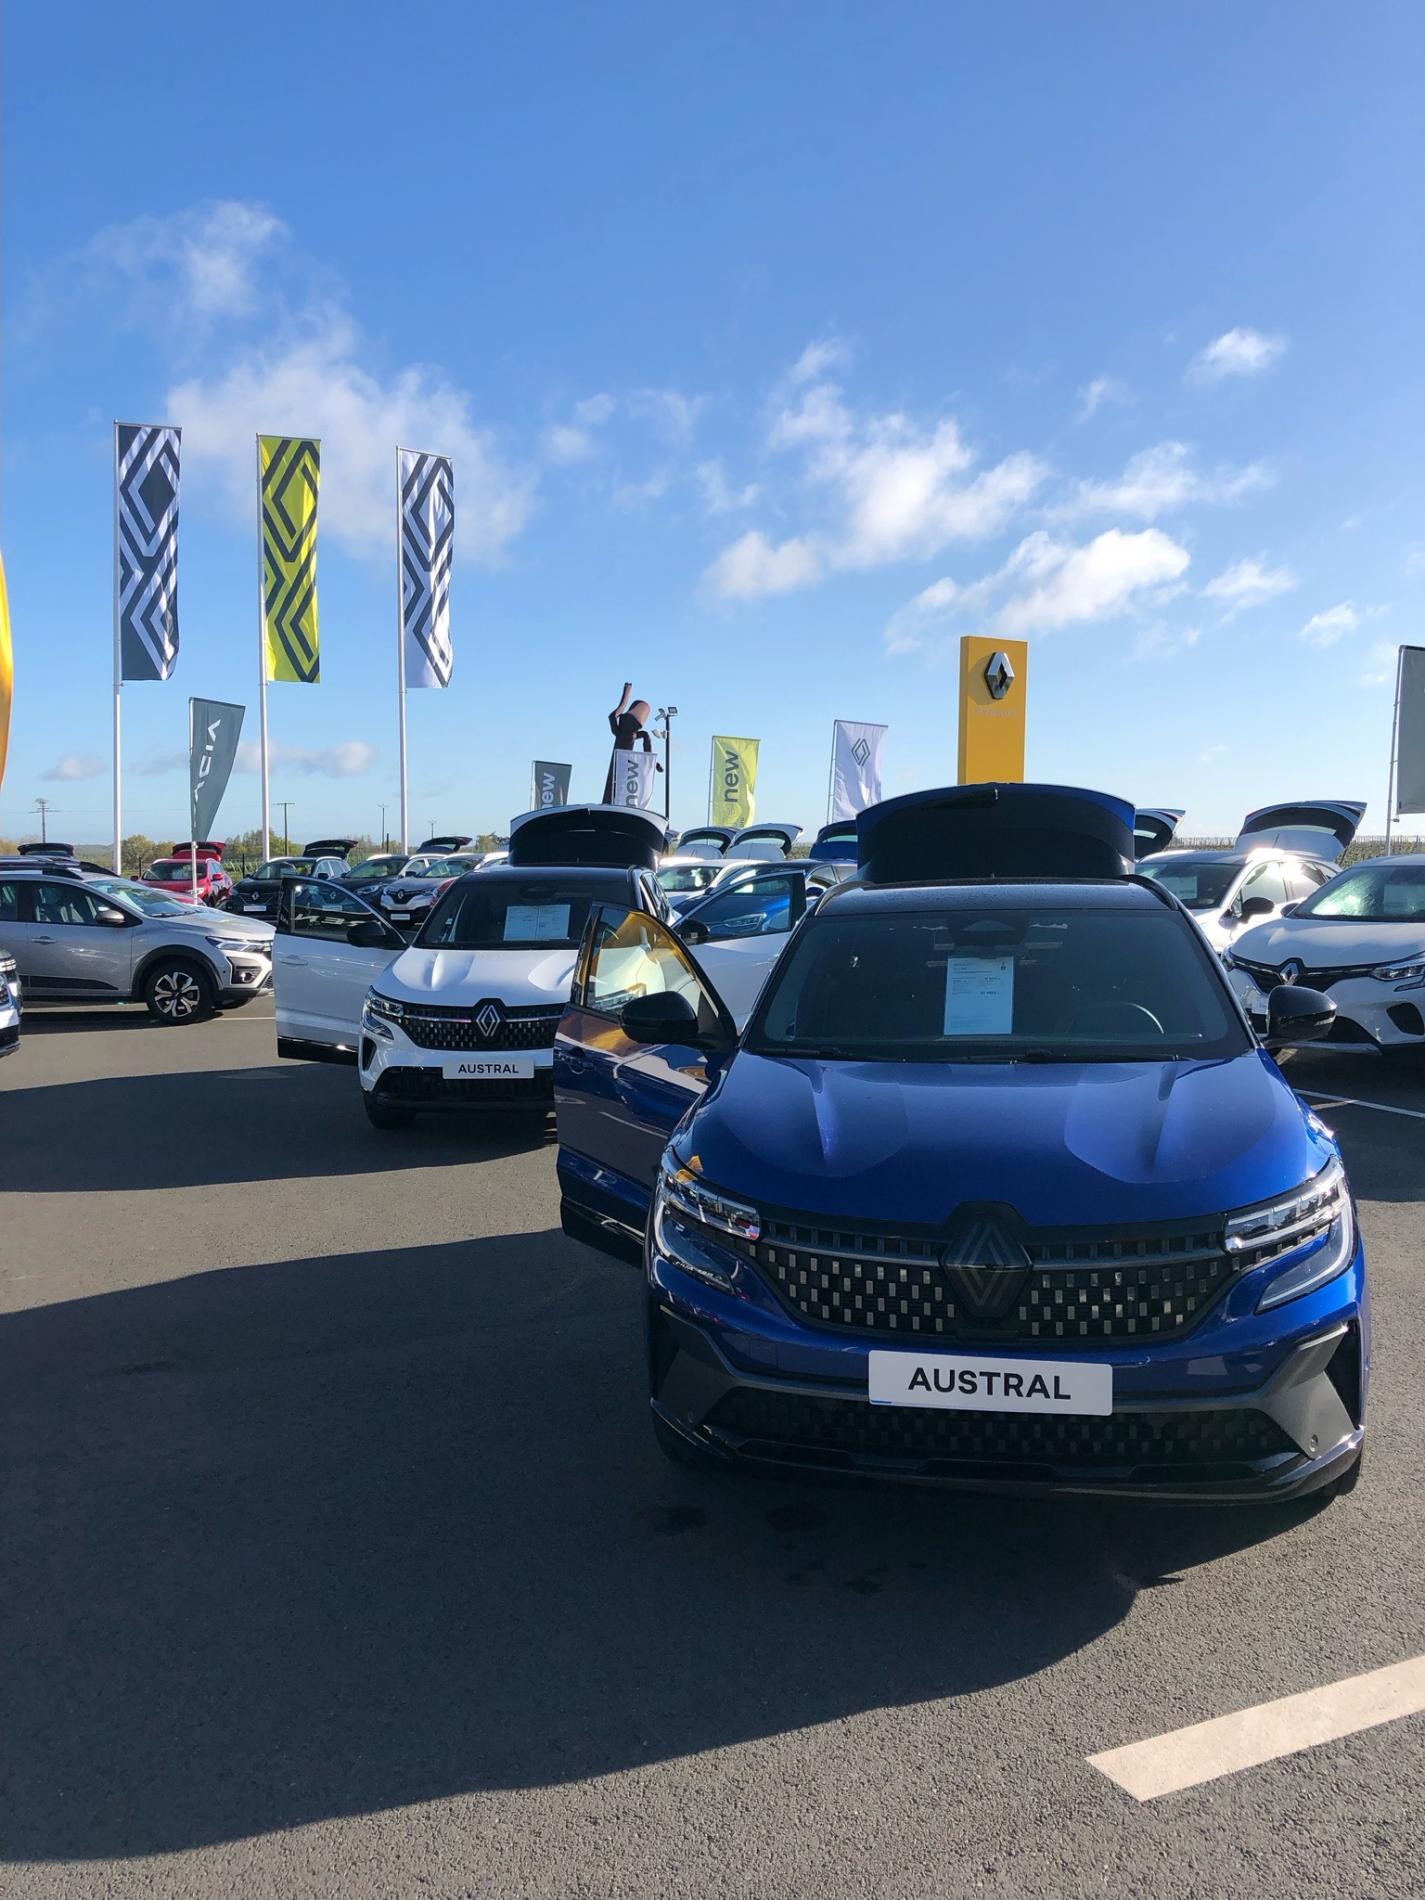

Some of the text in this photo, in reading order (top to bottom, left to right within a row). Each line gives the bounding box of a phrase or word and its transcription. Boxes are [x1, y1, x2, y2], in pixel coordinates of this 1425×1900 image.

[193, 719, 221, 829] ACIA
[625, 759, 639, 807] new
[724, 750, 739, 803] new
[458, 1064, 519, 1074] AUSTRAL
[907, 1367, 1071, 1400] AUSTRAL
